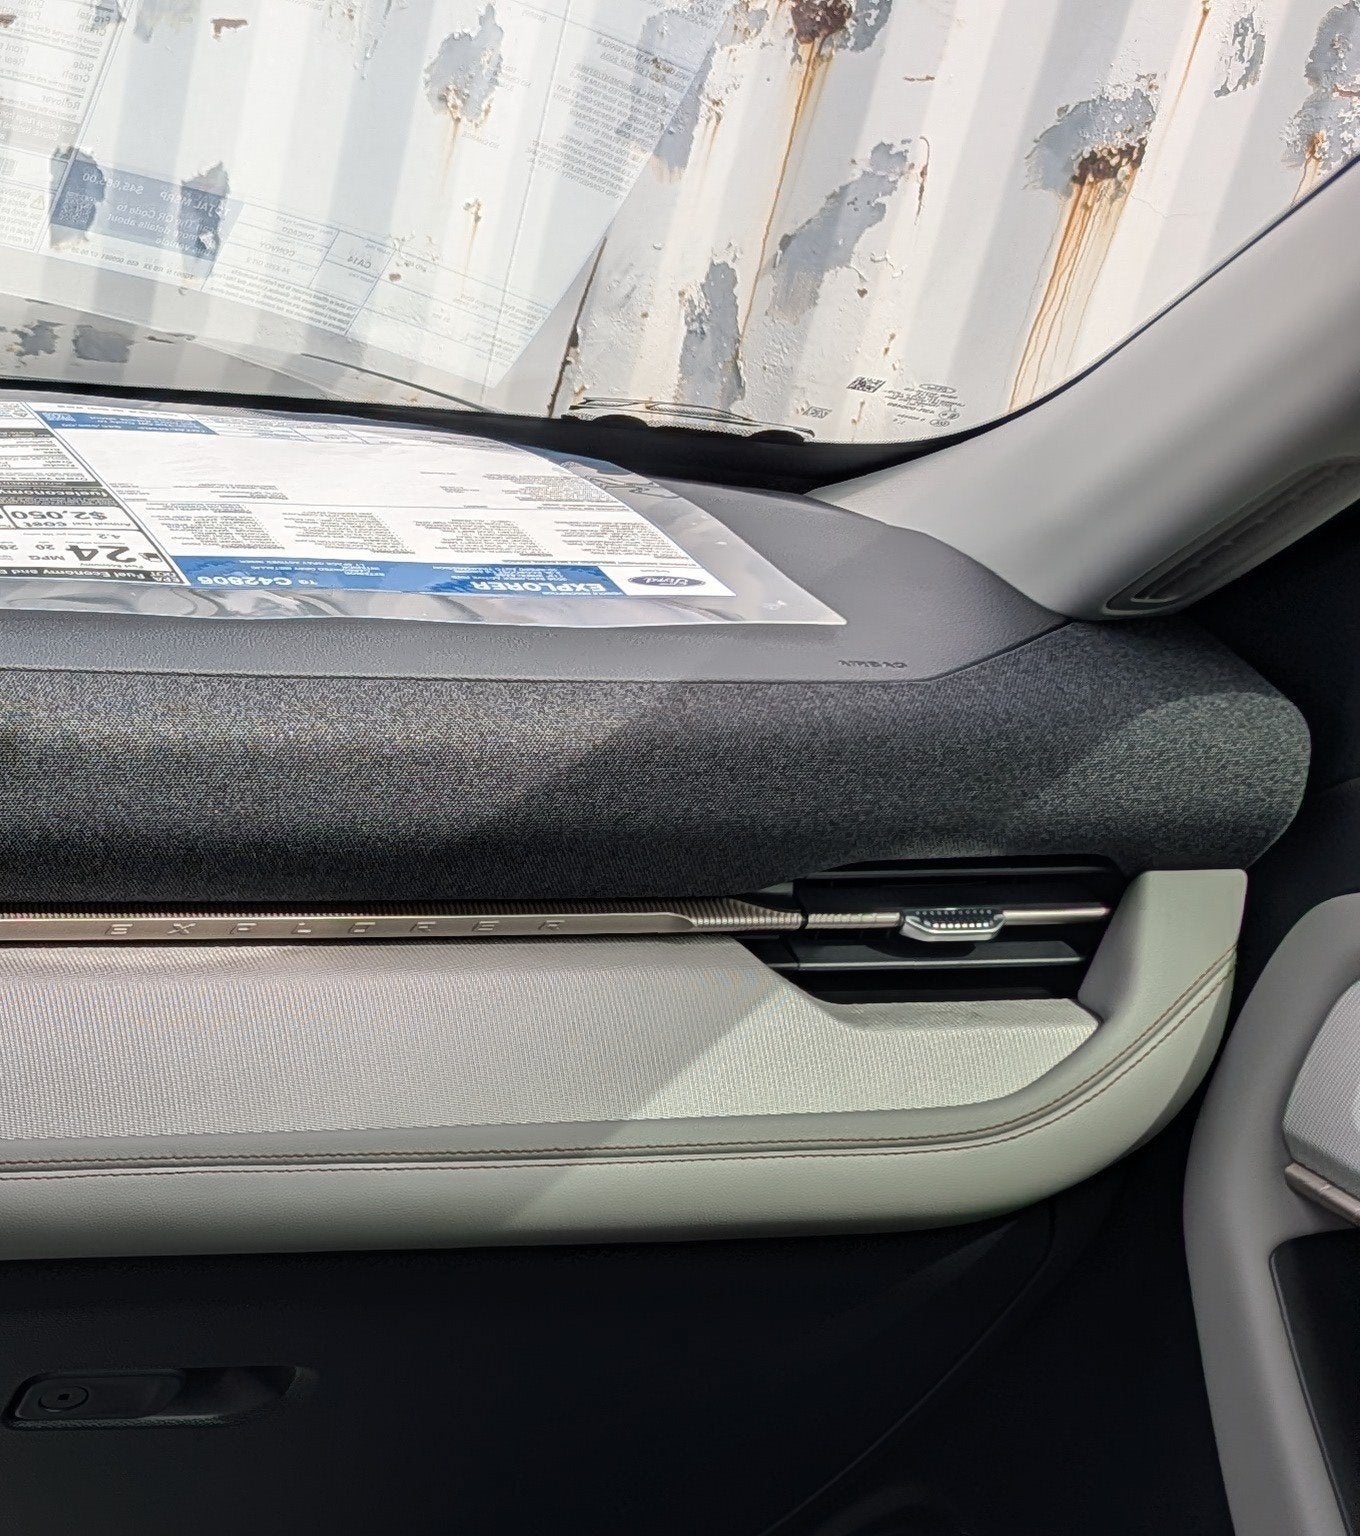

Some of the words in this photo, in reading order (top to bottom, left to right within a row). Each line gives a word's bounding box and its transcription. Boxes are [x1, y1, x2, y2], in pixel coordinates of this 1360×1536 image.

[10, 510, 107, 521] $2,050
[34, 543, 55, 551] 20
[65, 544, 138, 563] 24
[10, 567, 38, 575] and
[42, 567, 111, 578] Economy
[113, 571, 145, 579] Fuel
[196, 575, 293, 587] C42806
[469, 581, 605, 592] EXPLORER
